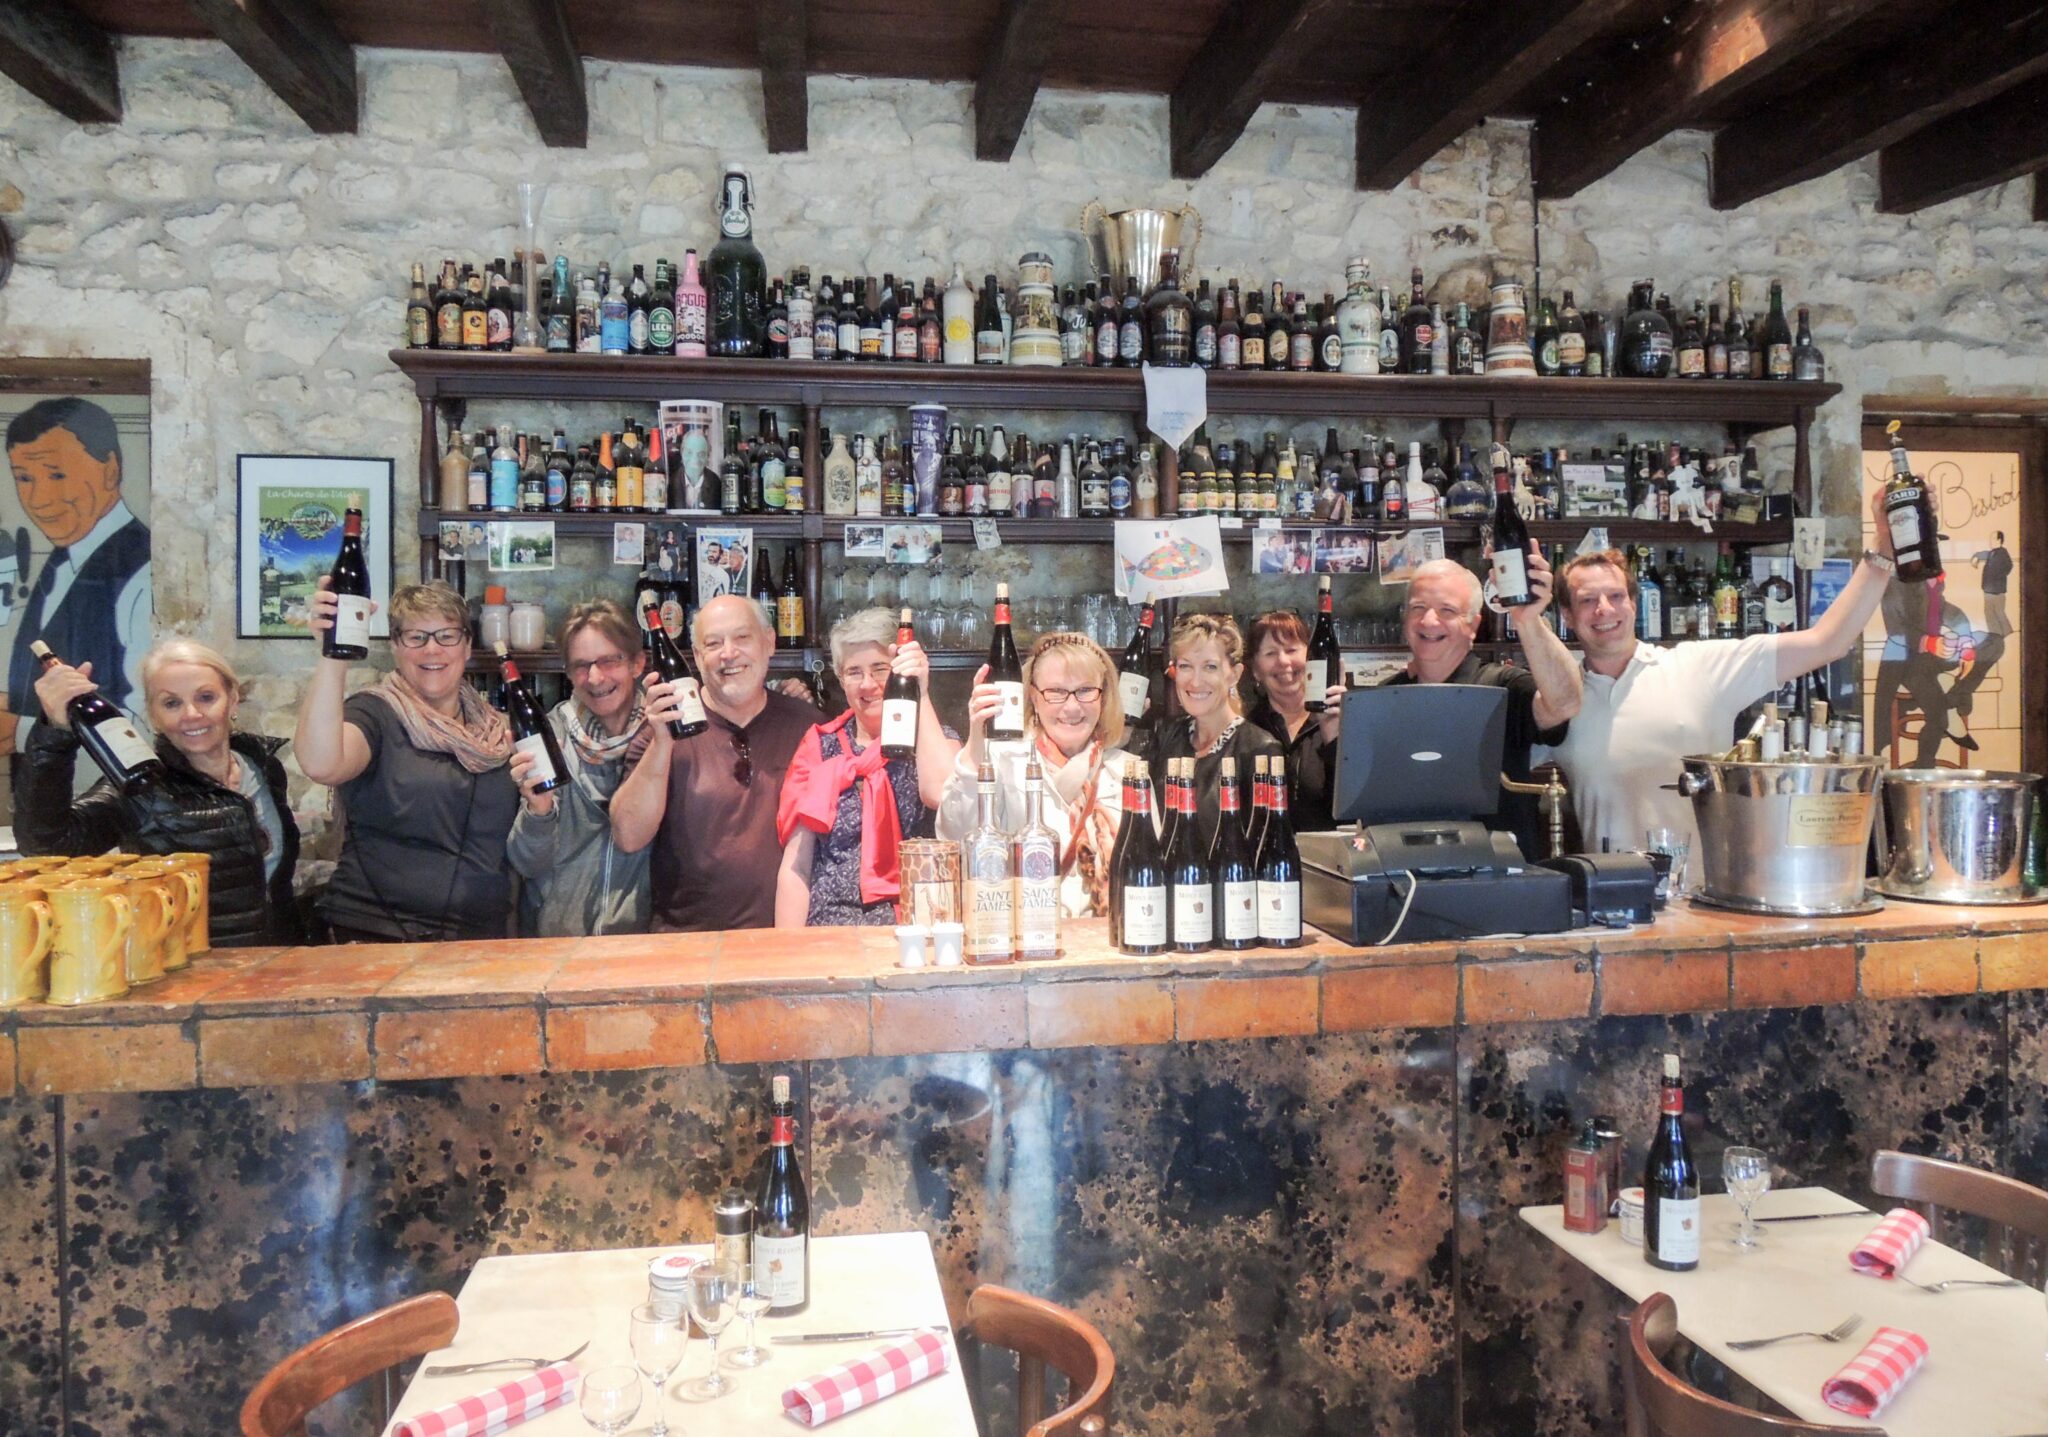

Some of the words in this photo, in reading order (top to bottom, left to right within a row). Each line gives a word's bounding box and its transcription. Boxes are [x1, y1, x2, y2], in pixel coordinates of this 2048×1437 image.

[675, 293, 706, 308] ROGUE
[651, 323, 673, 332] LECH
[1928, 460, 2020, 530] Bistrot
[976, 890, 1011, 902] SAINT
[1022, 887, 1058, 899] SAINT
[972, 899, 1012, 912] JAMES
[1018, 897, 1058, 908] JAMES
